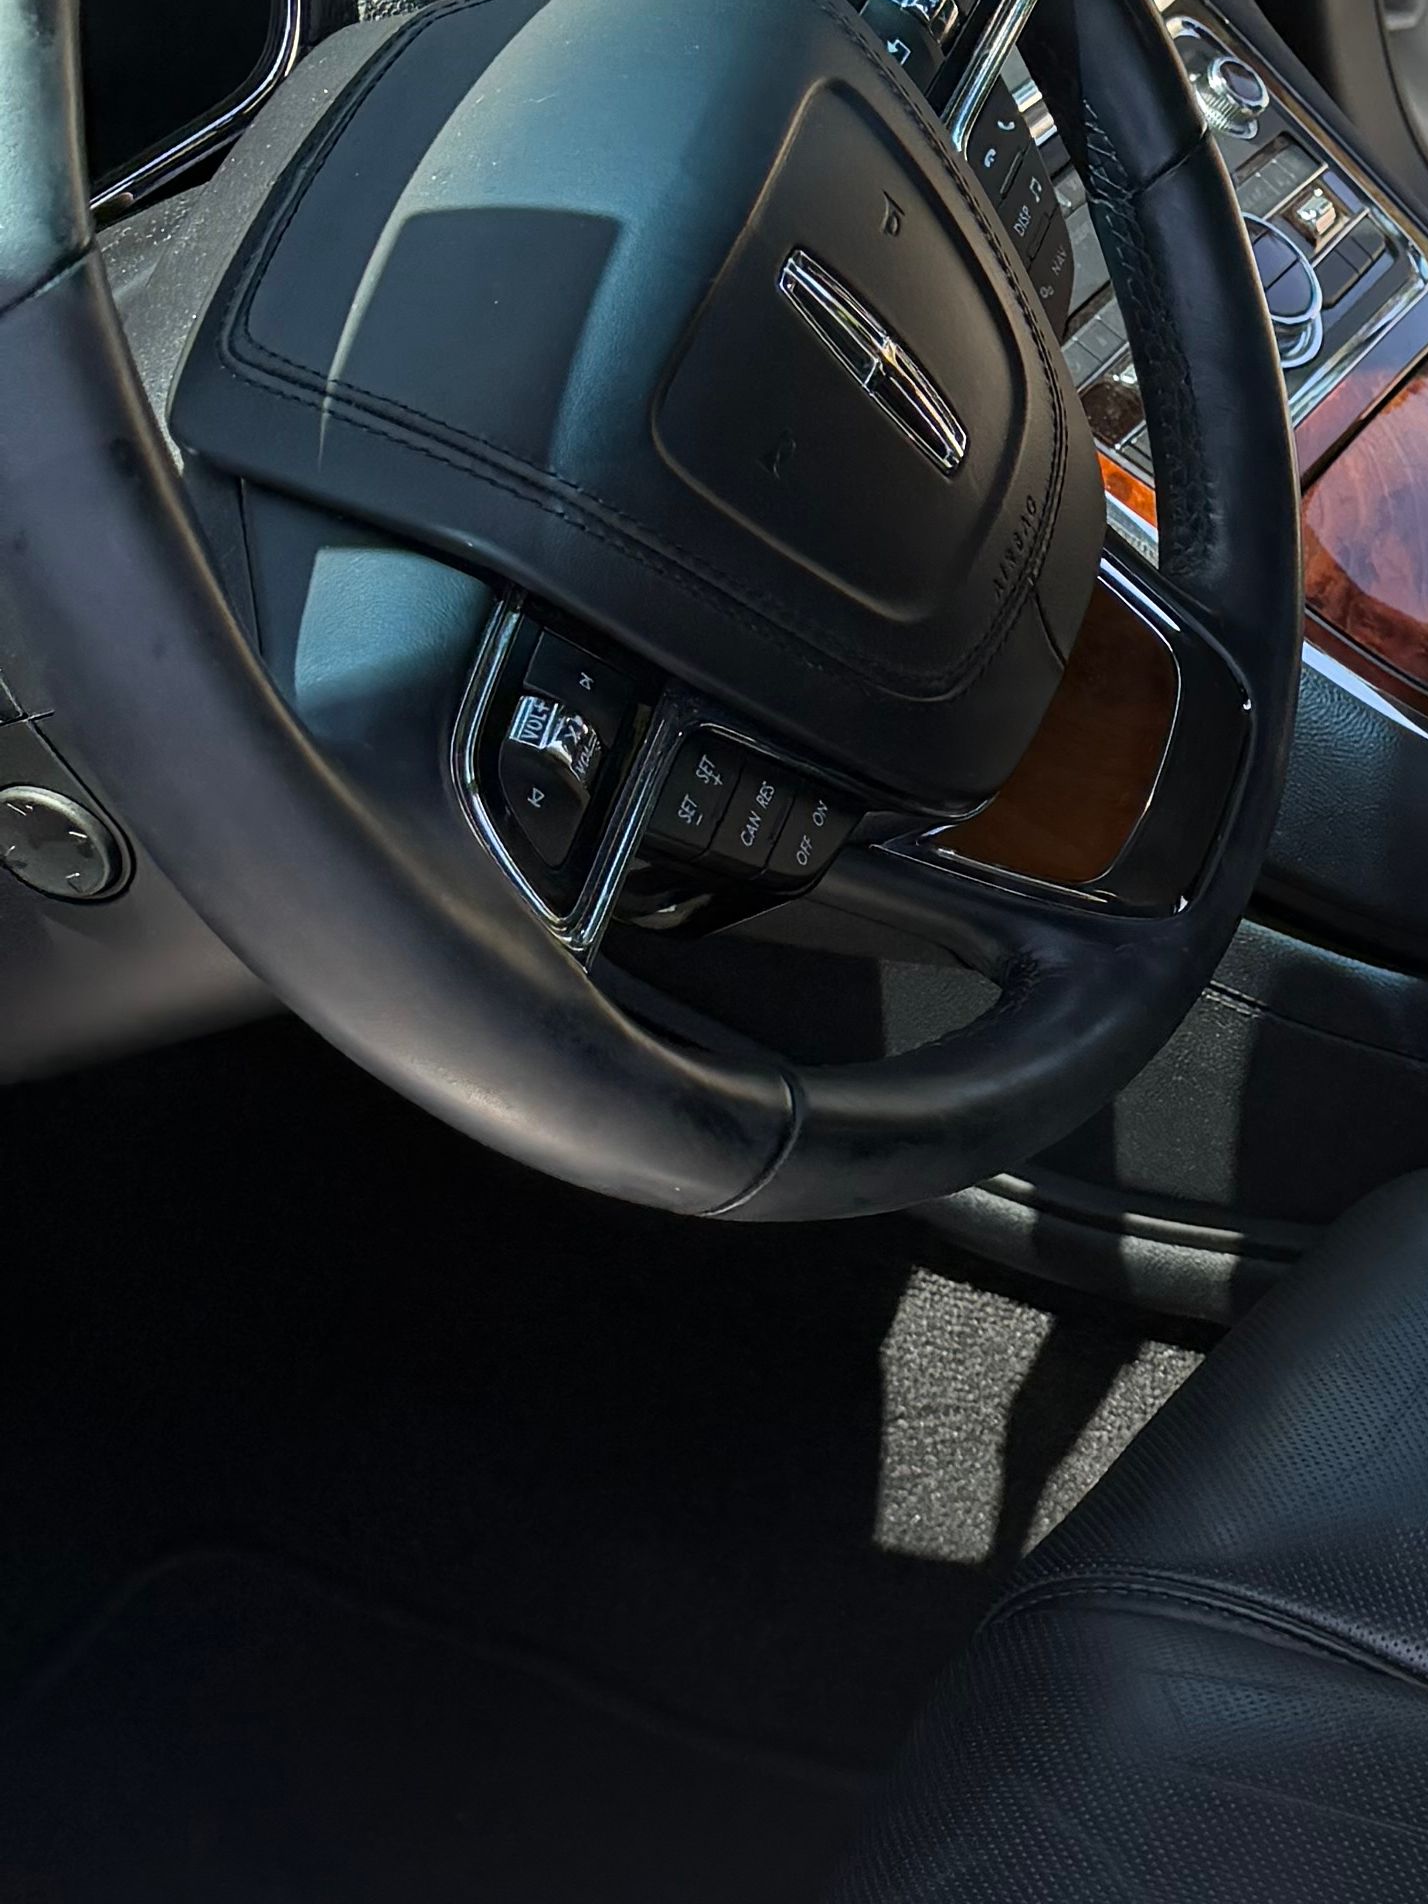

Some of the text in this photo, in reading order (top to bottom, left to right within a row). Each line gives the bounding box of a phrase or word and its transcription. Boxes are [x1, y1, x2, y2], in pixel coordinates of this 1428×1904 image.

[1013, 205, 1032, 238] DISP
[1051, 246, 1069, 277] NAV
[695, 754, 716, 784] SET
[678, 793, 698, 824] SET
[740, 780, 776, 847] CAN RES
[796, 799, 829, 866] OFF ON
